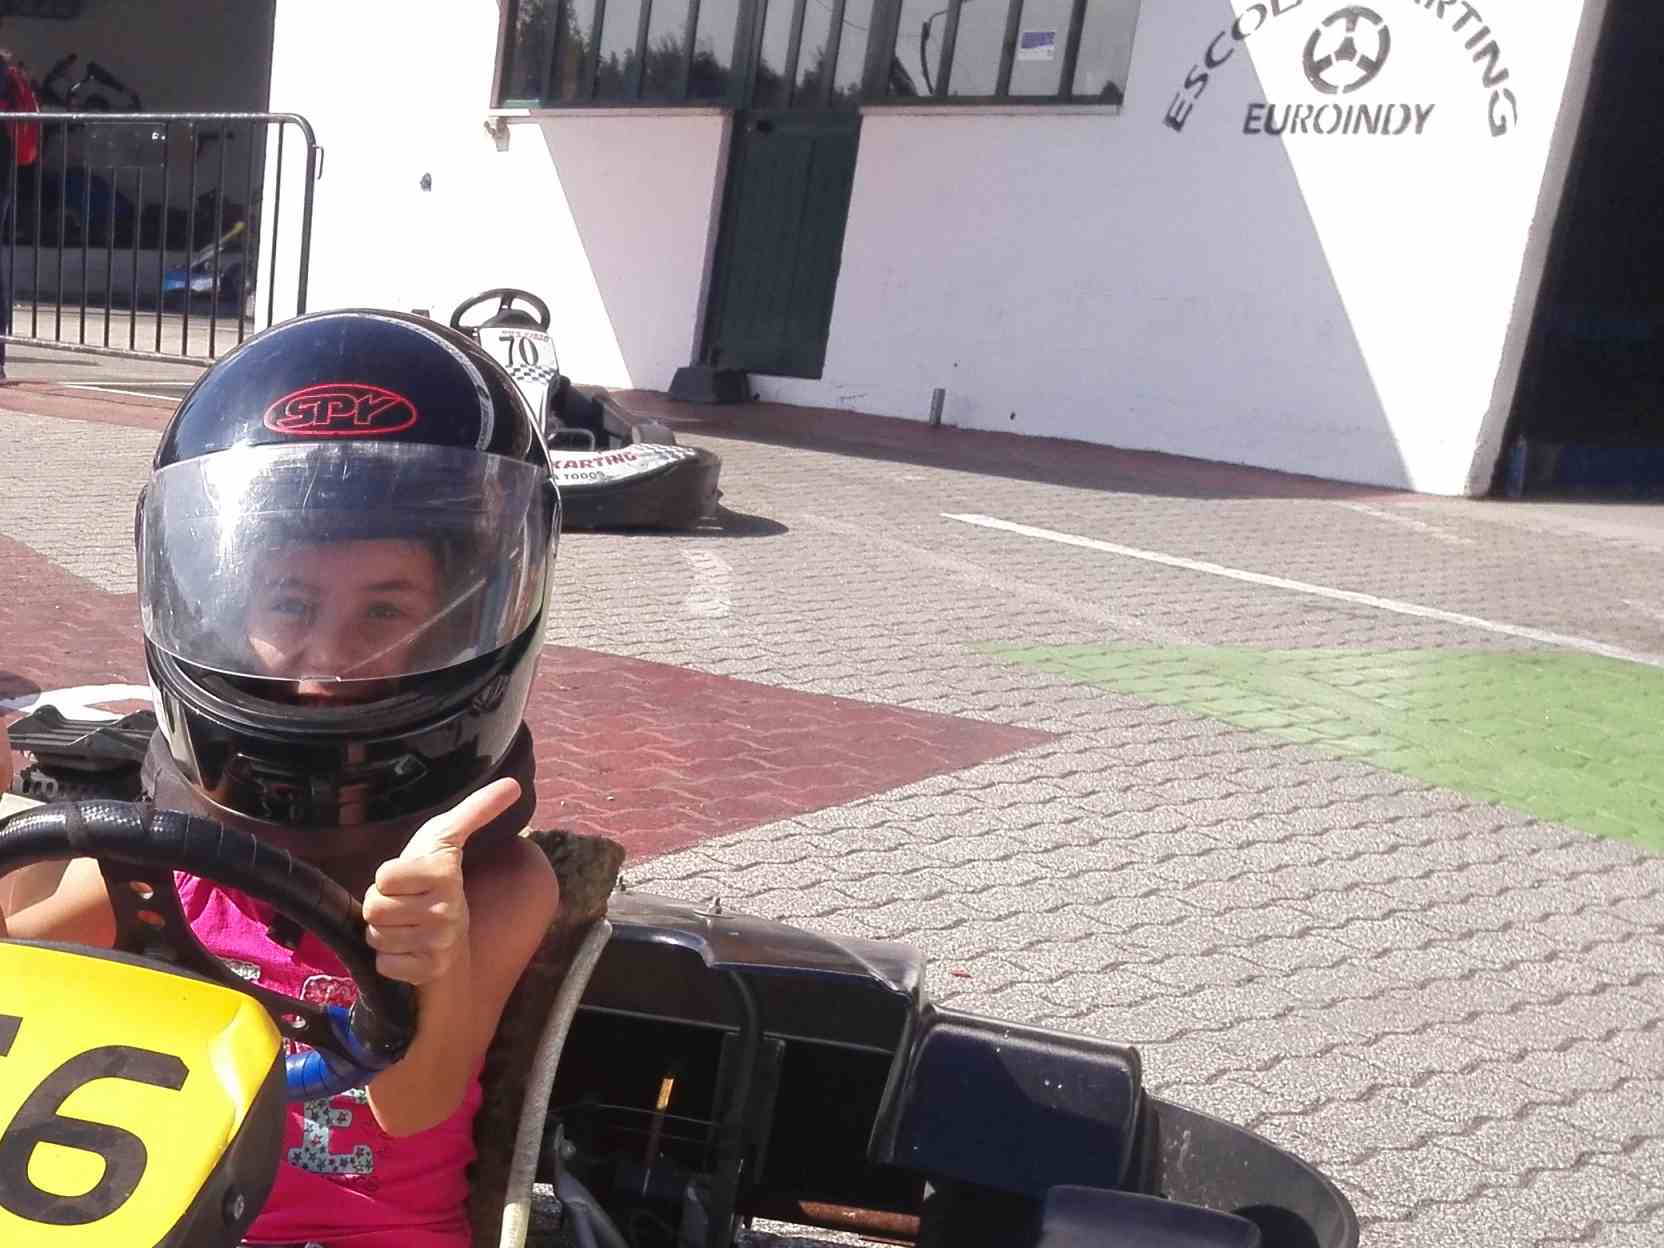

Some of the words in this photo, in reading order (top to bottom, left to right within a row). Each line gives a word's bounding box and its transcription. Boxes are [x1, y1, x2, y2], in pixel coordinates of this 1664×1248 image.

[1242, 103, 1436, 135] EUROINDY
[499, 335, 539, 367] 70
[277, 393, 400, 429] SPY
